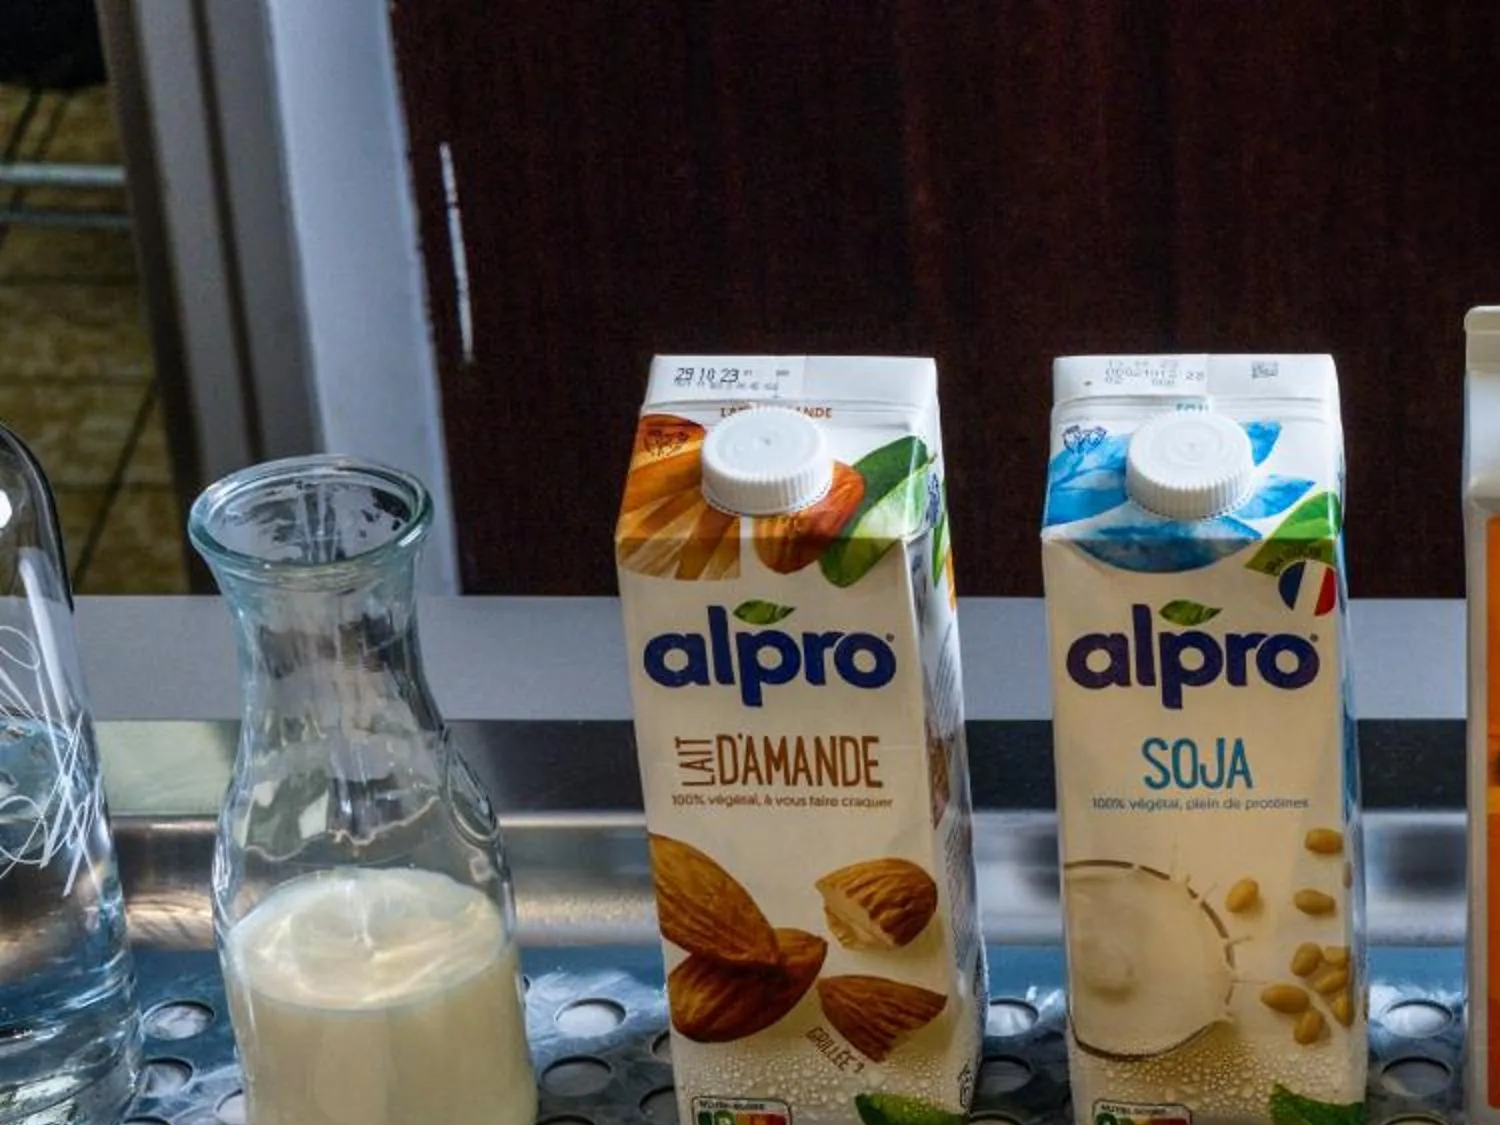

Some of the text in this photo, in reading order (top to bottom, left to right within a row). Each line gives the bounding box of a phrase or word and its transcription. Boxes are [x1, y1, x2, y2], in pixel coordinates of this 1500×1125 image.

[719, 368, 739, 384] 23
[643, 604, 897, 708] alpro
[1065, 603, 1320, 710] alpro
[674, 736, 716, 787] LAIT
[715, 732, 884, 788] D'AMANDE
[1141, 736, 1254, 790] SOJA
[775, 796, 807, 808] vous
